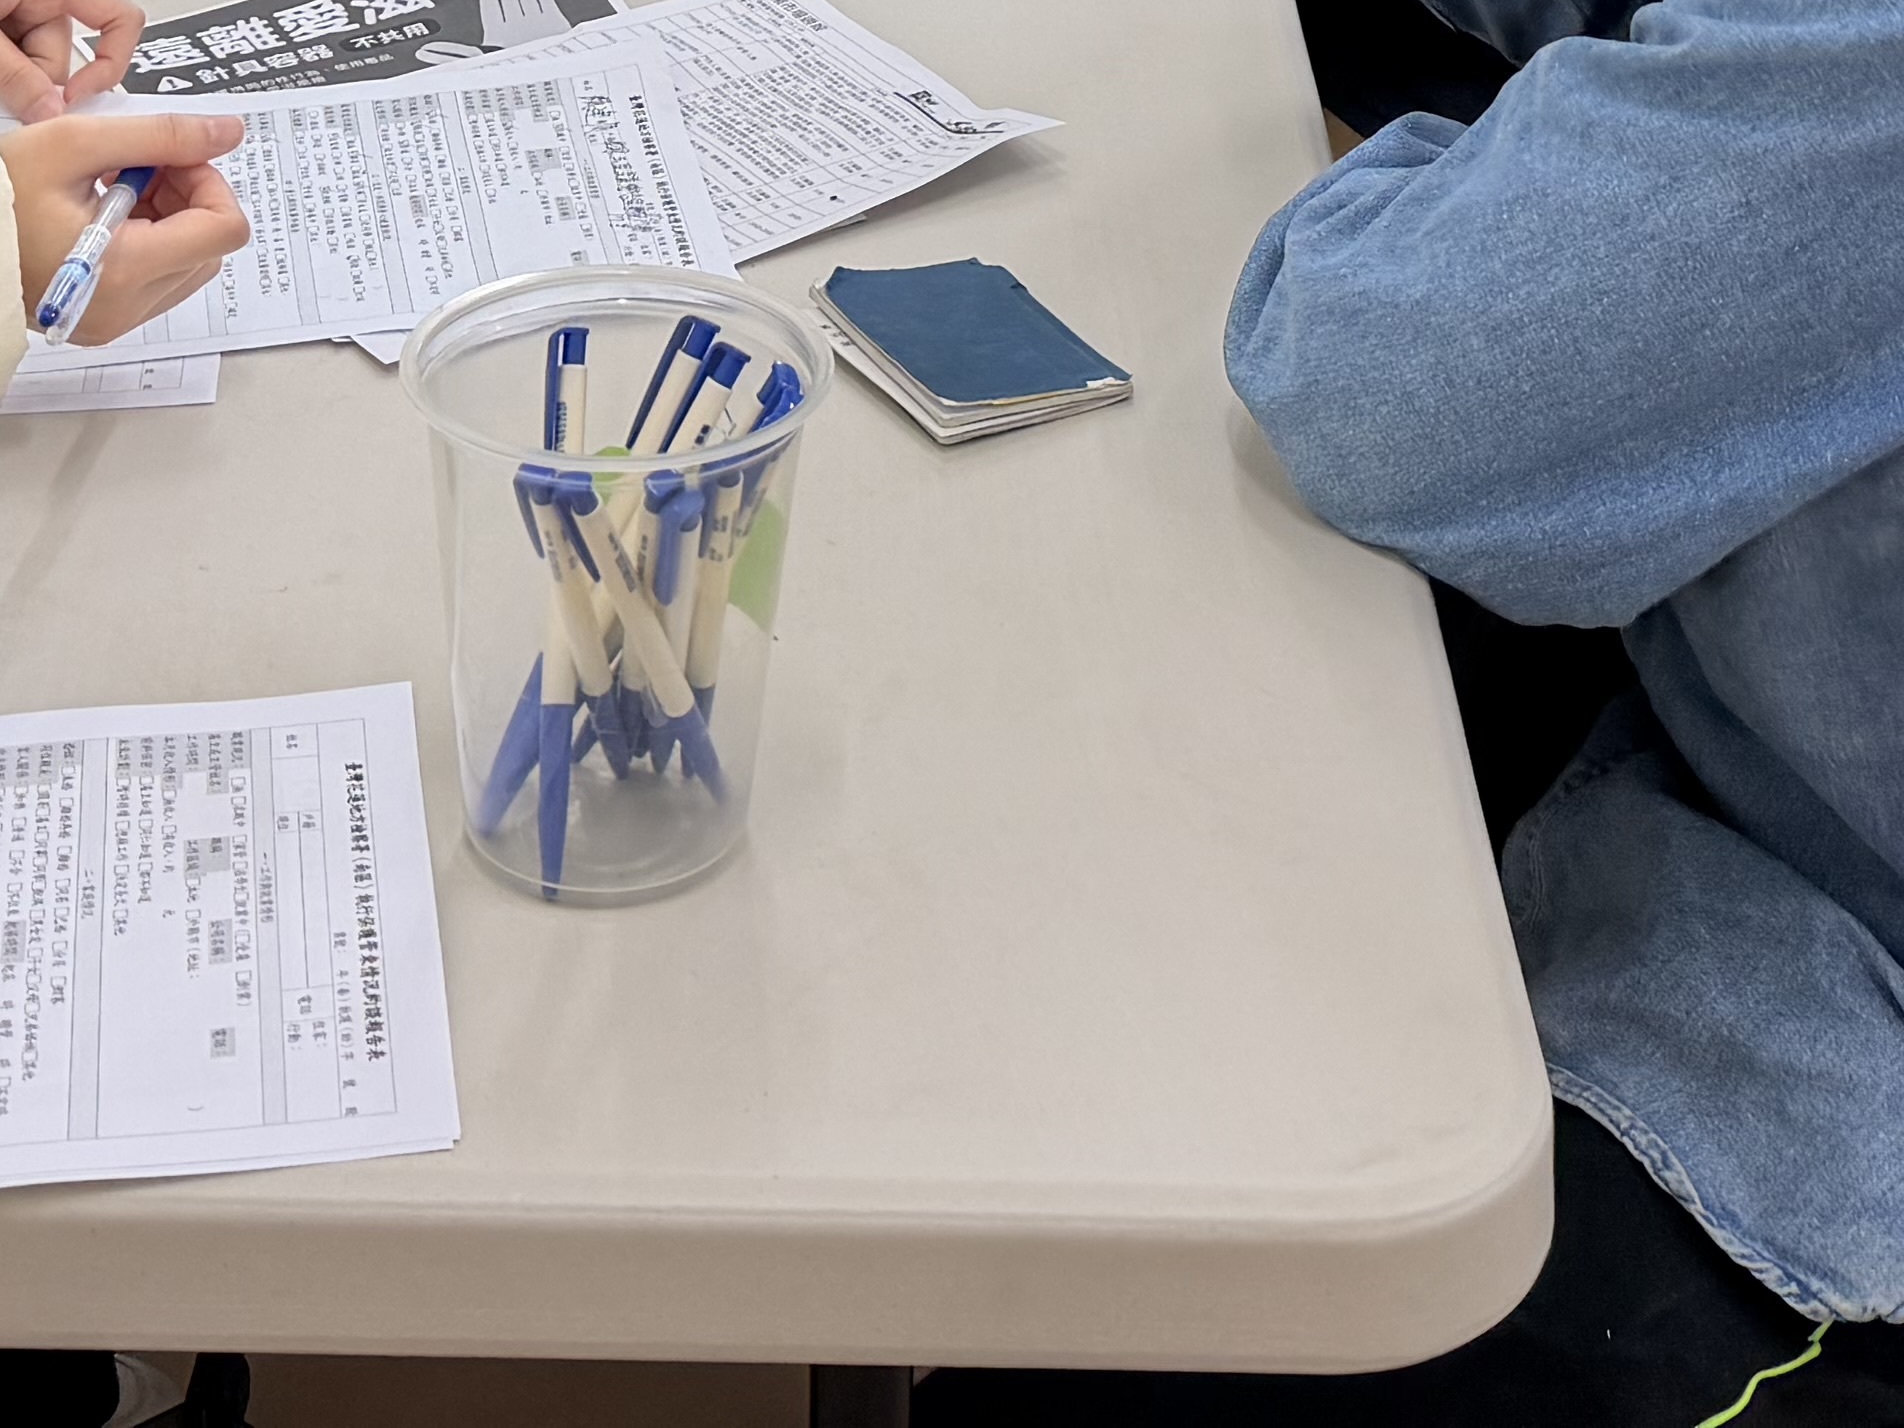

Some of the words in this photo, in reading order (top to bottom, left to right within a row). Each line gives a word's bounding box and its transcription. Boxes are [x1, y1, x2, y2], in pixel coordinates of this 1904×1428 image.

[195, 44, 333, 84] 針具容器
[349, 21, 429, 49] 不共用
